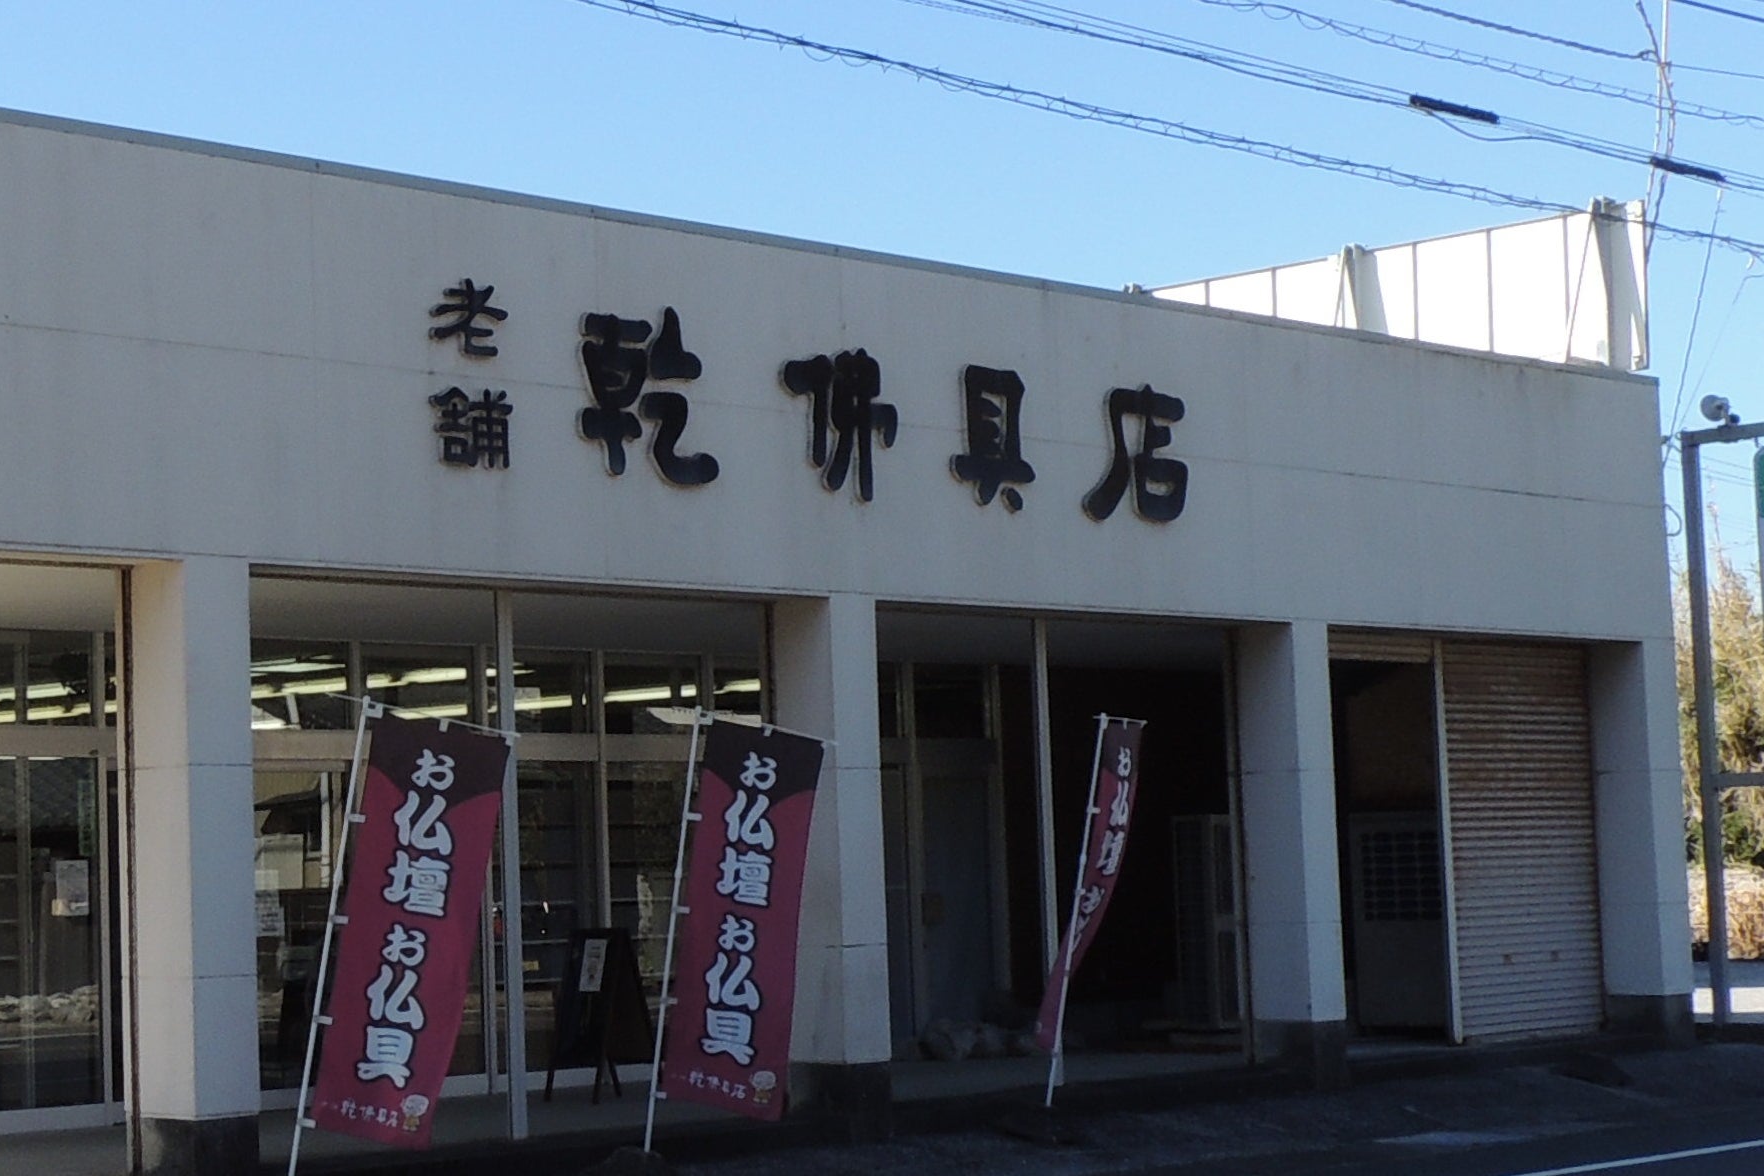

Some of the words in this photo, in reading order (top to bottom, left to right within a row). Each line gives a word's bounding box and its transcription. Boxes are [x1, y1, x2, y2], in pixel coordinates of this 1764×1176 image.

[429, 277, 512, 471] 老舗
[382, 748, 456, 918] お仏壇
[716, 751, 778, 908] お仏壇
[356, 923, 428, 1089] お仏具
[700, 913, 761, 1067] お仏具
